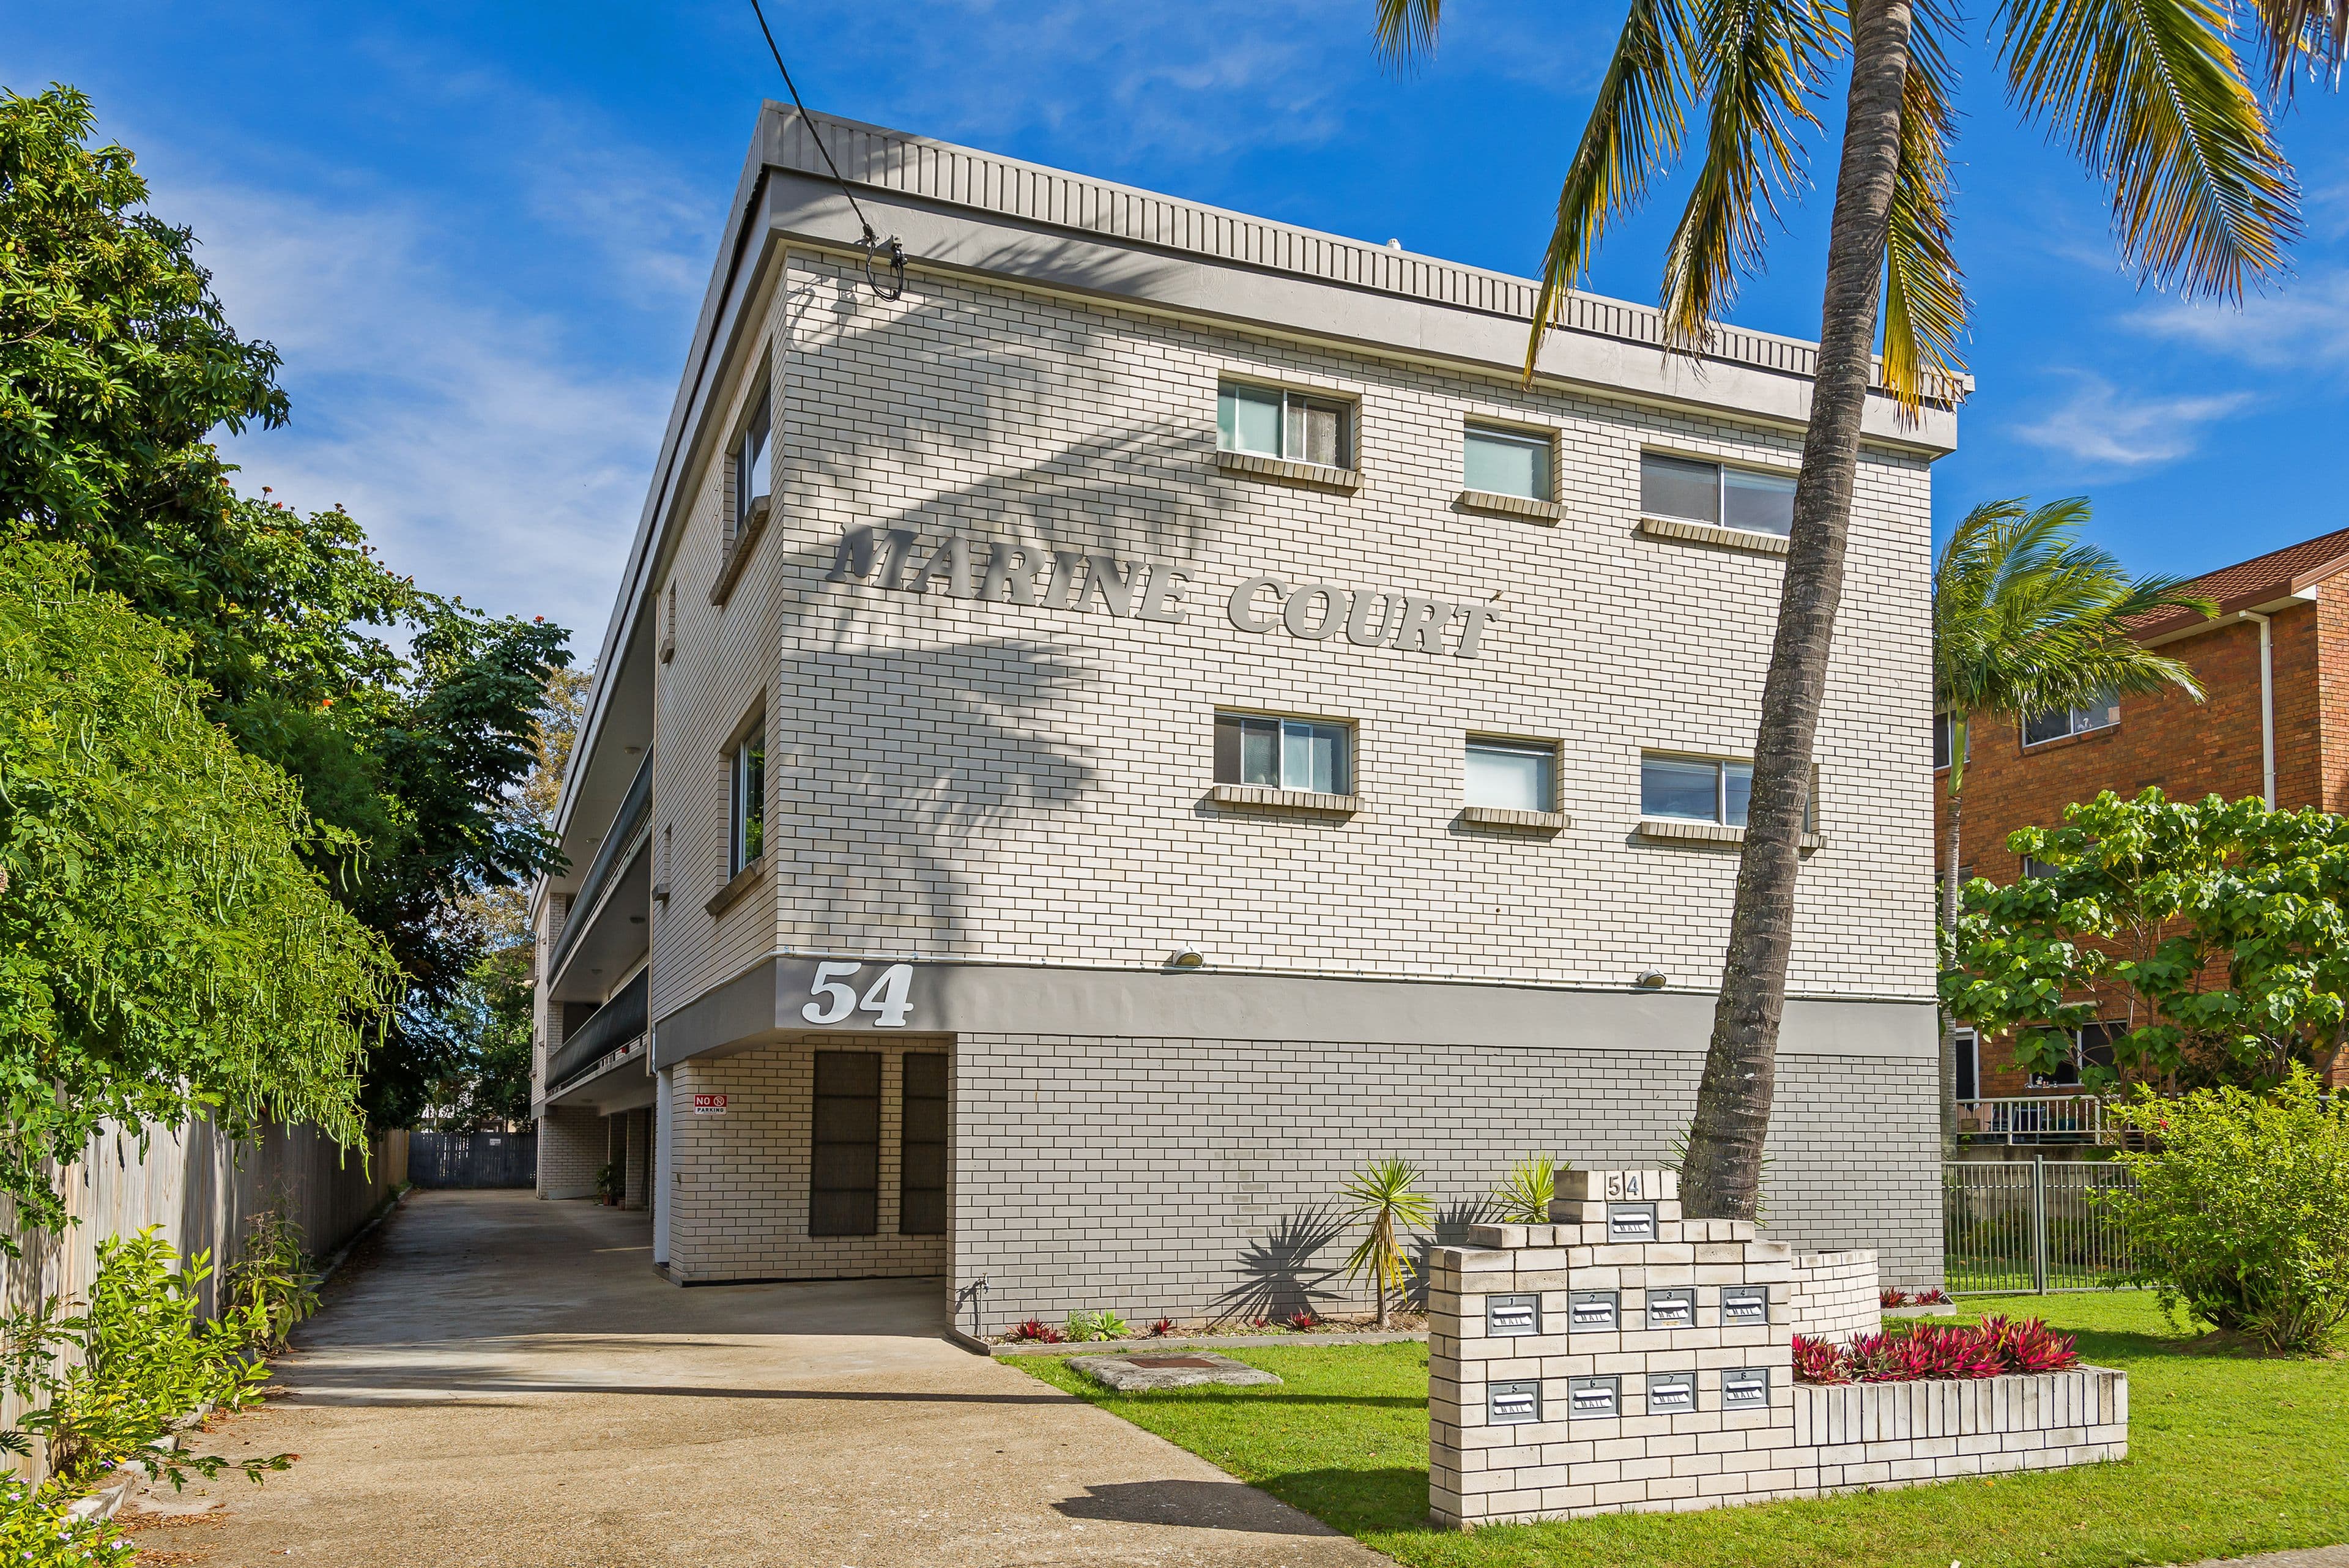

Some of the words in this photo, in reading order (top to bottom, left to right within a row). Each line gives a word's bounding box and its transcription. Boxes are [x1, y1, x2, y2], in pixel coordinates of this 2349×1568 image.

[825, 522, 1195, 623] MARINE
[1227, 576, 1499, 659] COURT
[802, 962, 914, 1027] 54
[1609, 1175, 1639, 1196] 54
[1589, 1294, 1595, 1302] 2
